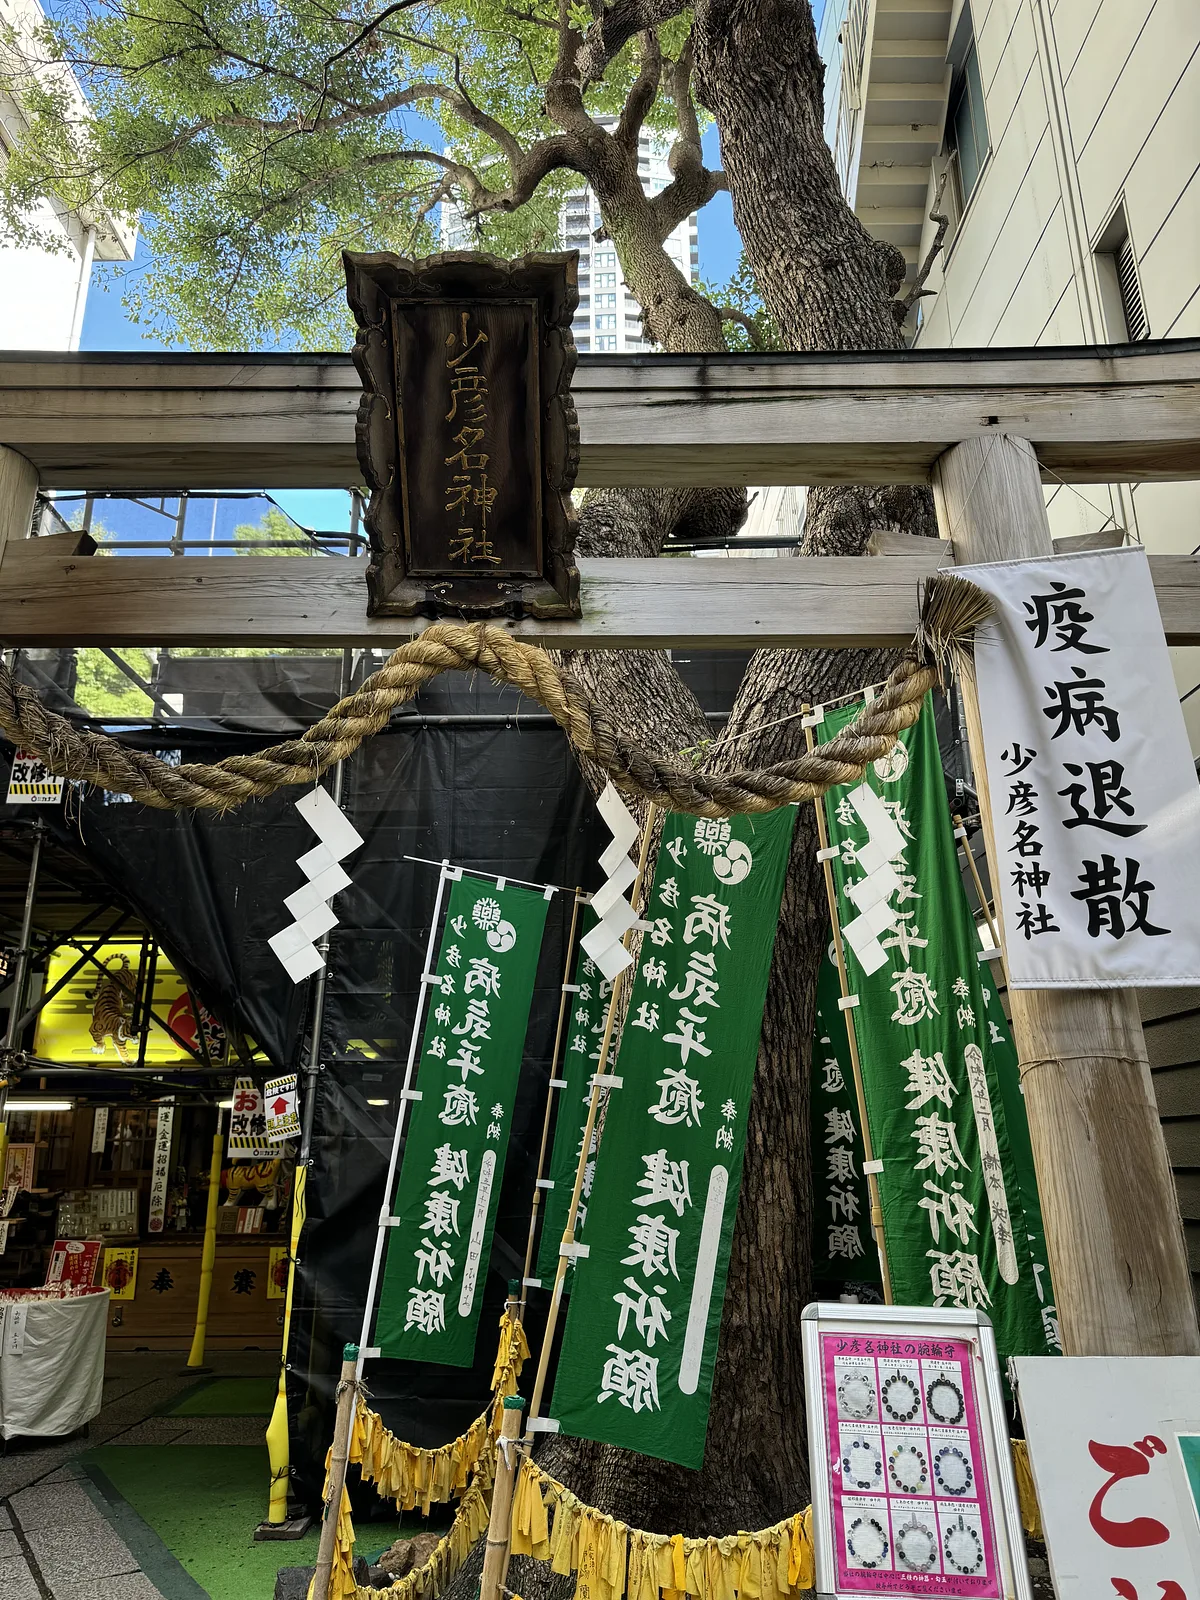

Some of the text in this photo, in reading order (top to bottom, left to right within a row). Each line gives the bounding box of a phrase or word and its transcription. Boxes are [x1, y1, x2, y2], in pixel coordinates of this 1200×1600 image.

[444, 312, 502, 565] 少彦名神社
[1000, 742, 1061, 940] 少彦名神社
[1022, 581, 1172, 940] 疫病退散
[835, 1338, 956, 1359] 少彦名神社の腕輪守
